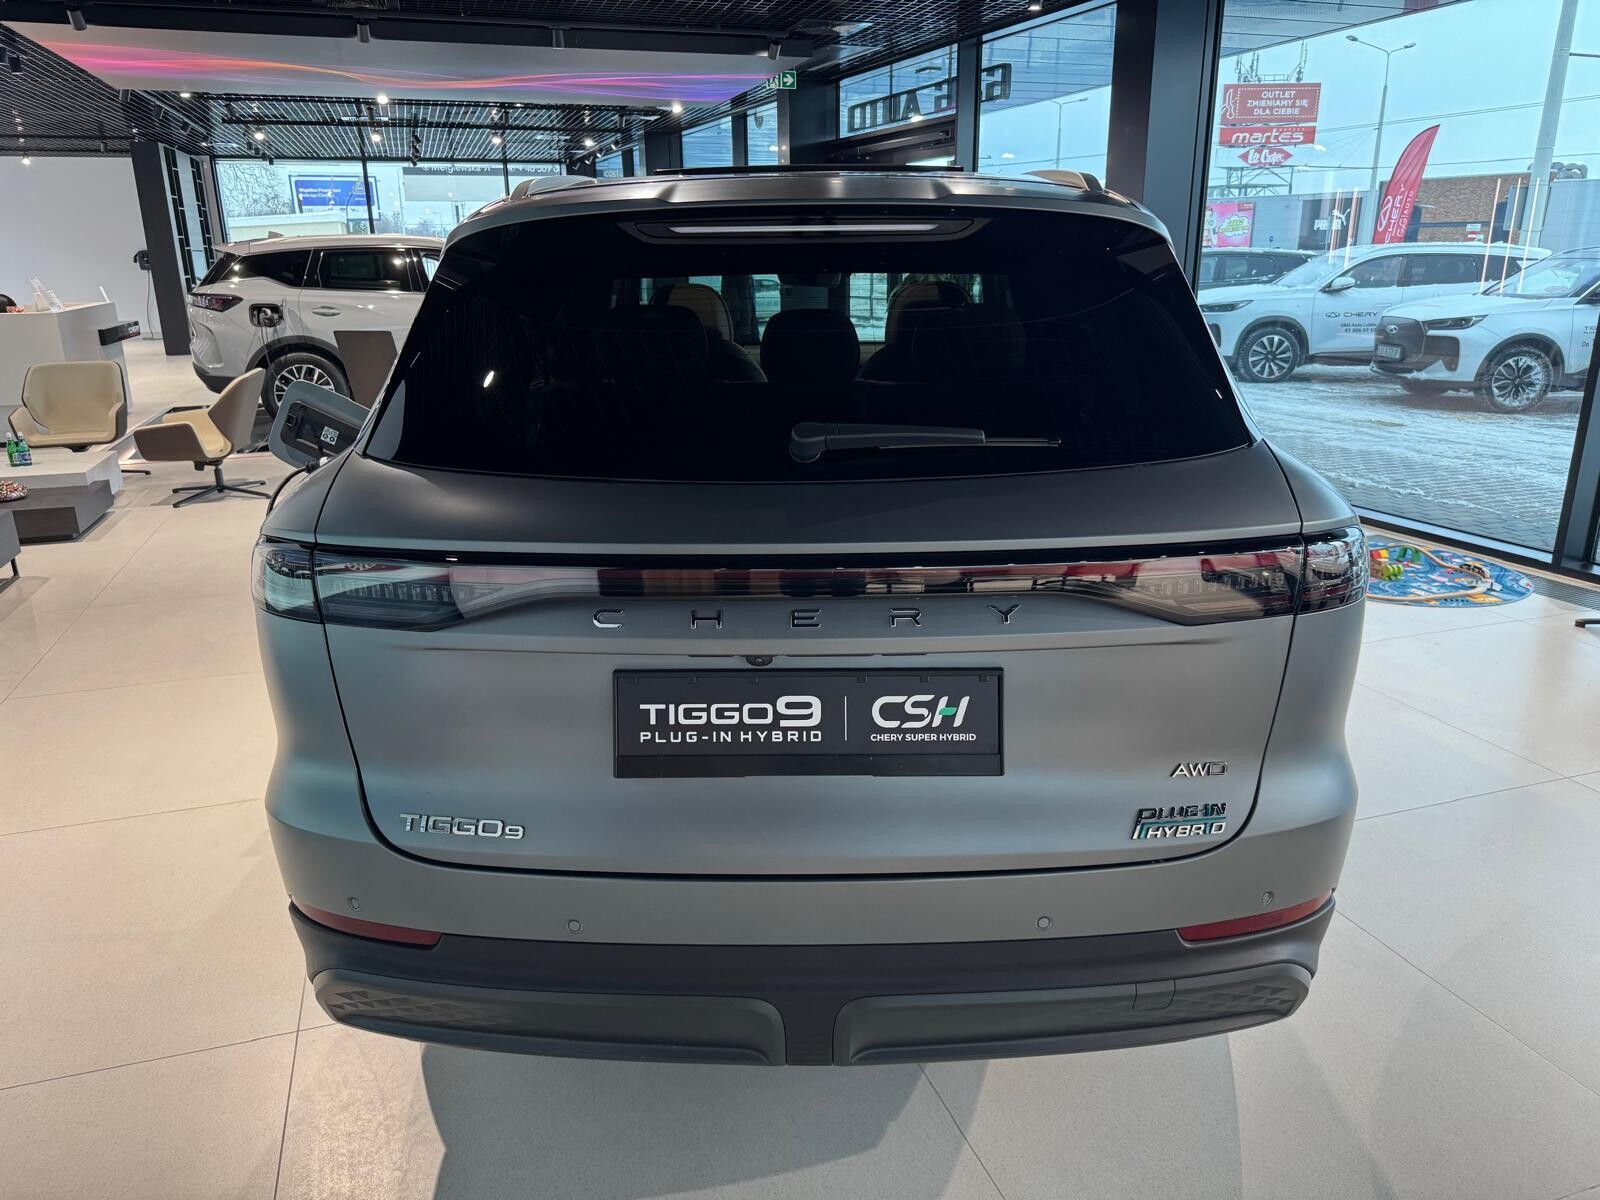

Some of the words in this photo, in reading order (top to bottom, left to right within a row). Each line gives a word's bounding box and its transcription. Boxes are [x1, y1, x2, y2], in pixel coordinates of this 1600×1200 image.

[1247, 99, 1294, 107] ZMIENIAMY
[1295, 99, 1309, 107] SIĘ
[1273, 107, 1300, 115] CIEBIE
[1231, 128, 1304, 143] martes
[592, 603, 1022, 630] CHERY
[639, 695, 822, 727] TIGGO9
[871, 694, 971, 729] CSH
[639, 731, 733, 743] PLUG-IN
[740, 731, 822, 743] HYBRID
[870, 732, 903, 742] CHERY
[905, 732, 938, 742] SUPER
[939, 732, 977, 742] HYBRID
[1170, 762, 1228, 778] AWD
[1134, 803, 1227, 826] PLUG-IN
[399, 813, 525, 840] TIGGO9
[1146, 822, 1226, 839] HYBRID
